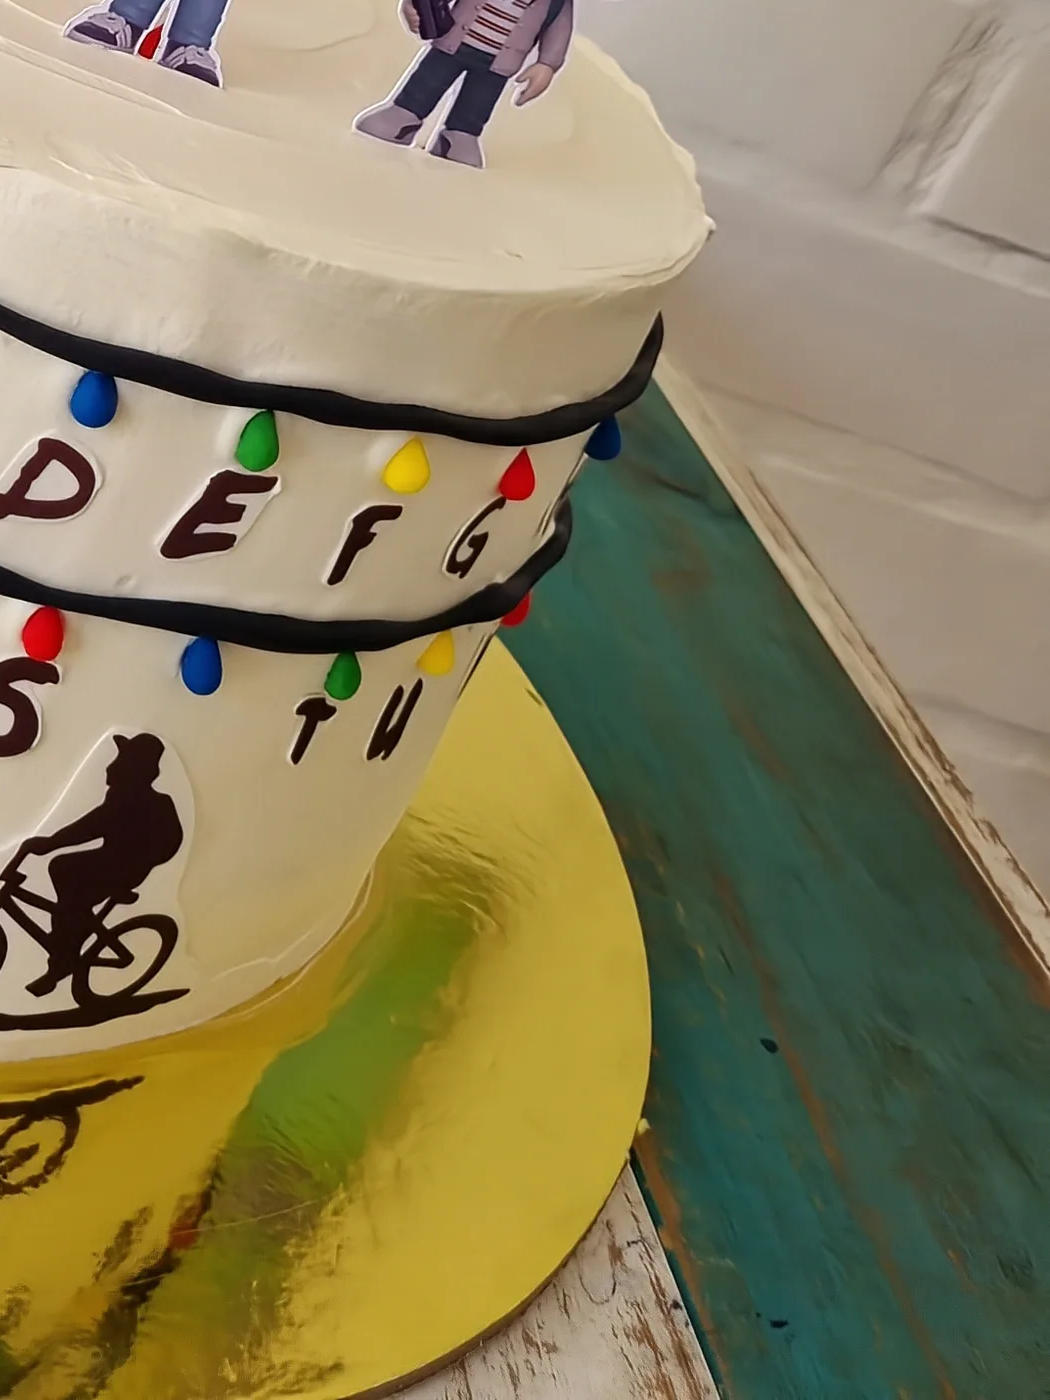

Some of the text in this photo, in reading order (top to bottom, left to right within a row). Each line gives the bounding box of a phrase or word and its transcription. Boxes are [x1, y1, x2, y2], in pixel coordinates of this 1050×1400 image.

[159, 468, 279, 560] E
[325, 504, 403, 585] F
[445, 496, 507, 579] G
[287, 696, 337, 765] T
